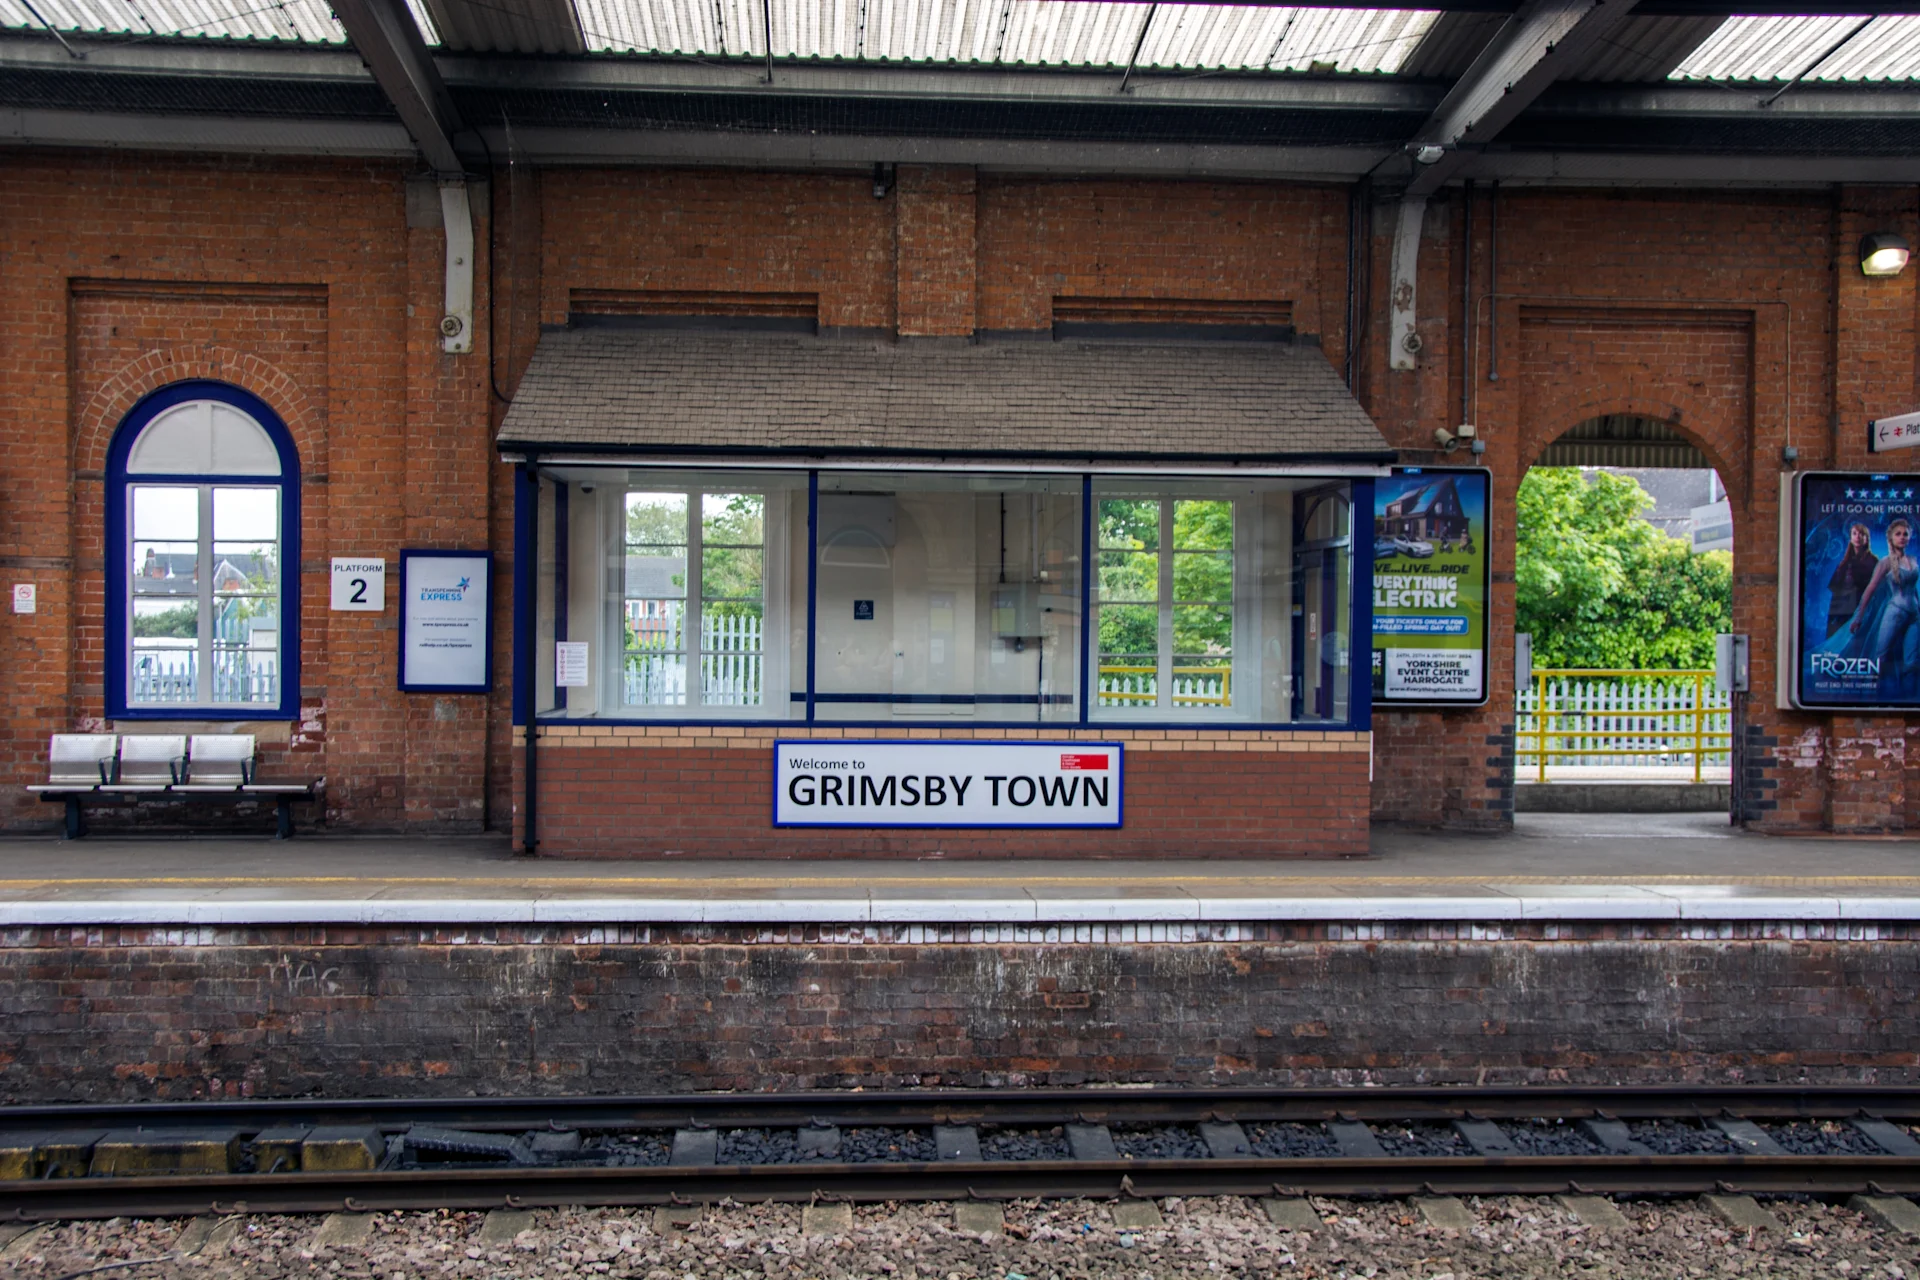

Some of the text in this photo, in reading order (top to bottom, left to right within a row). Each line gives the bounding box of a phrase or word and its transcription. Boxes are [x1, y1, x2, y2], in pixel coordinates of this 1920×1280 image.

[1821, 504, 1835, 513] LET
[1838, 504, 1844, 513] IT
[1846, 504, 1863, 513] GO
[1865, 504, 1885, 513] ONE
[1887, 504, 1912, 514] MORE
[334, 564, 383, 572] PLATFORM
[350, 578, 367, 603] 2
[420, 592, 463, 601] EXPRESS
[1373, 589, 1457, 608] LECTRIC
[1406, 660, 1461, 668] YORKSHIRE
[1811, 653, 1880, 678] FROZEN
[1397, 668, 1470, 676] EVENT CENTRE
[1404, 676, 1464, 684] HARROGATE
[789, 758, 865, 769] Welcome to
[788, 775, 1109, 807] GRIMSBY TOWN
